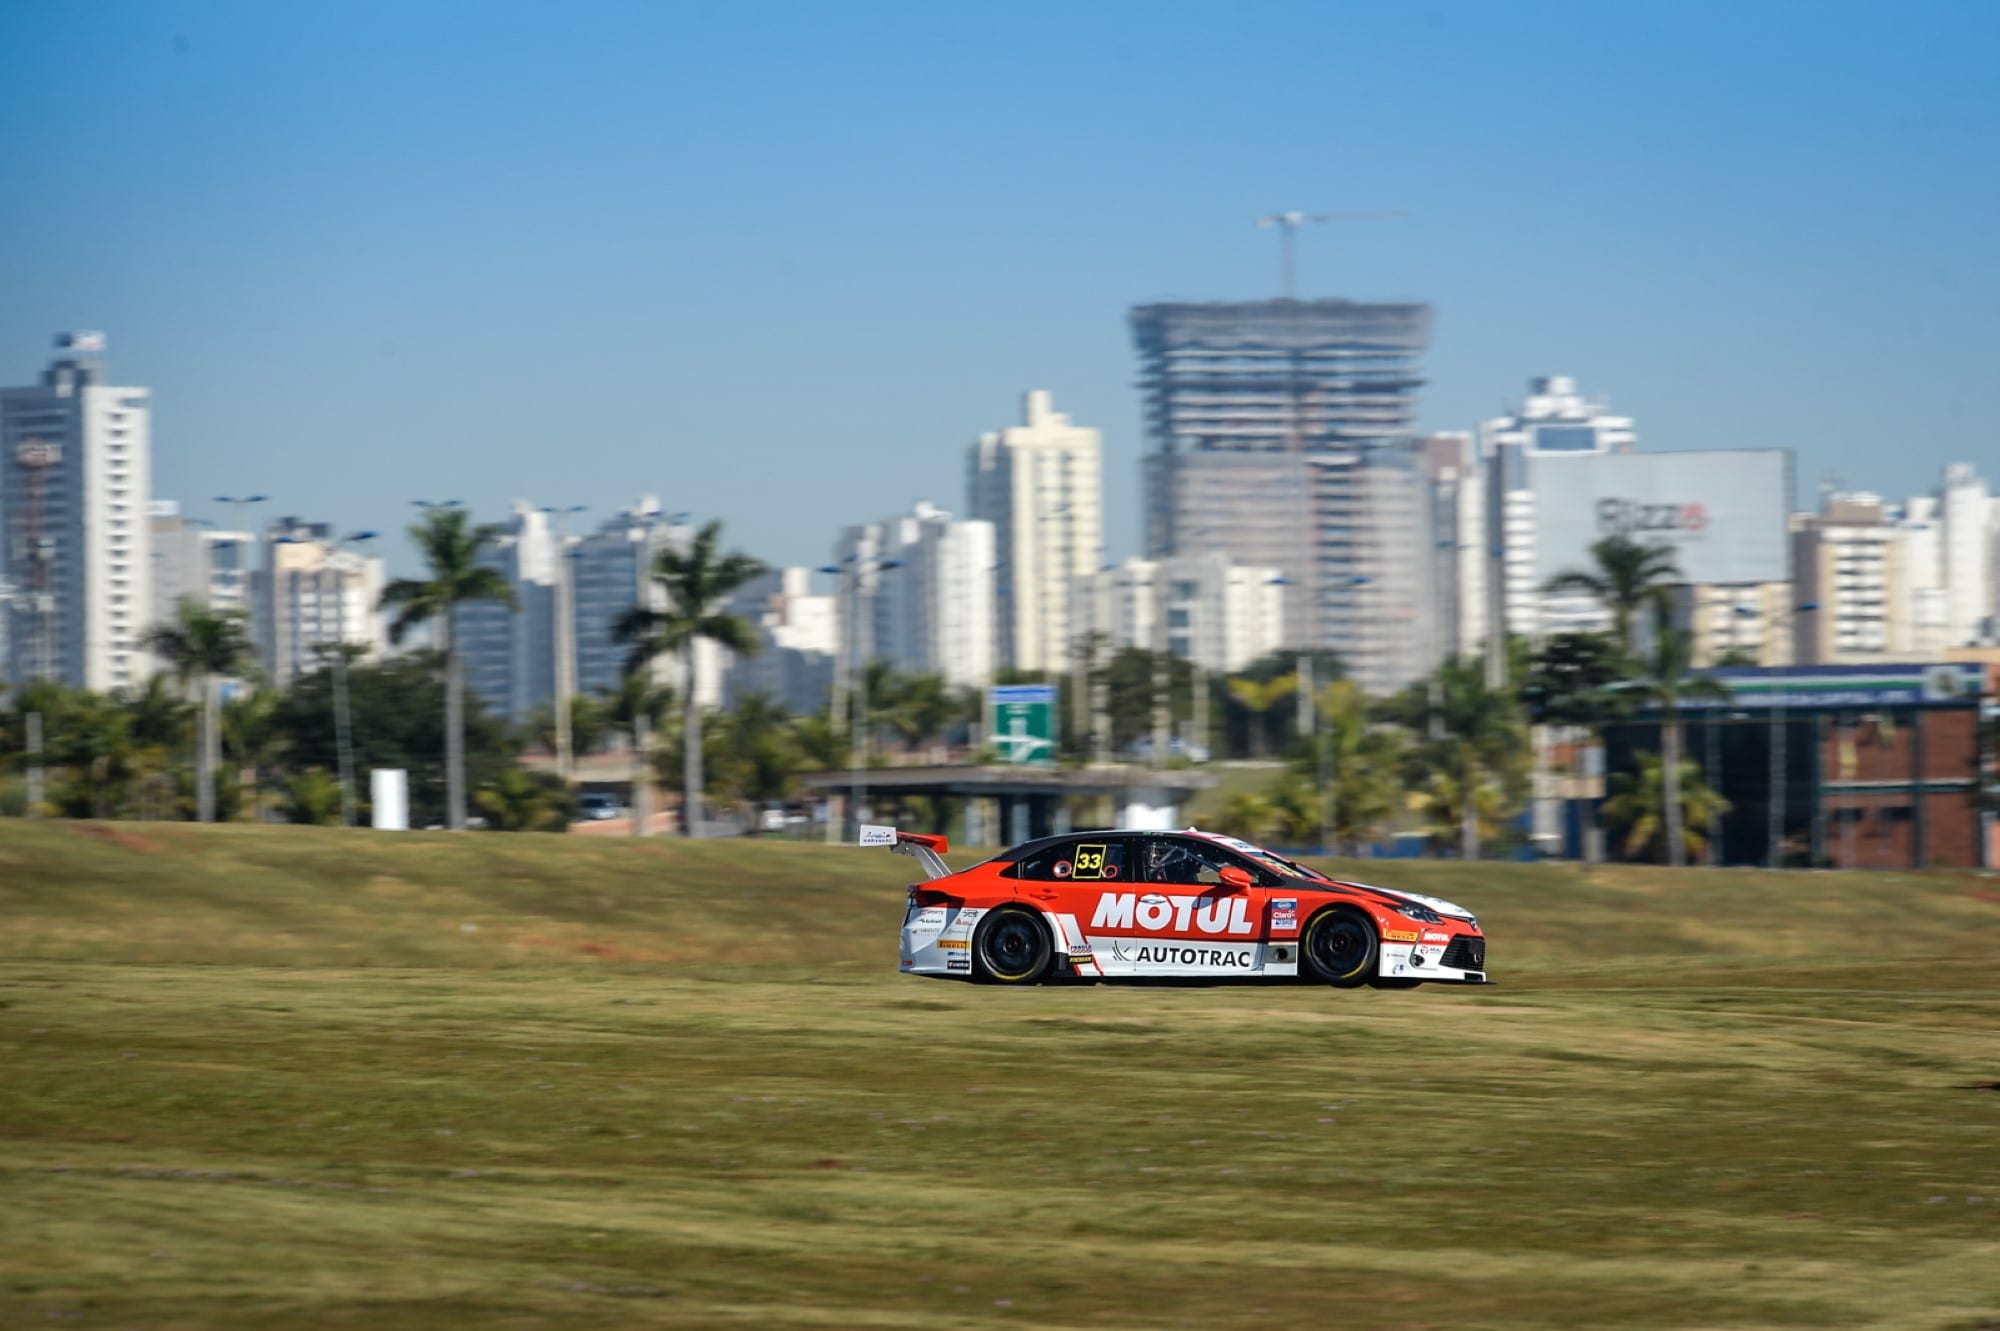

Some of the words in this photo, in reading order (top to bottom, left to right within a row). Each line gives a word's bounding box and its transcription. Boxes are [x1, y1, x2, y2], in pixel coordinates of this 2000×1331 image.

[1077, 853, 1101, 869] 33
[1091, 893, 1253, 934] MOTUL
[1137, 947, 1250, 967] AUTOTRAC
